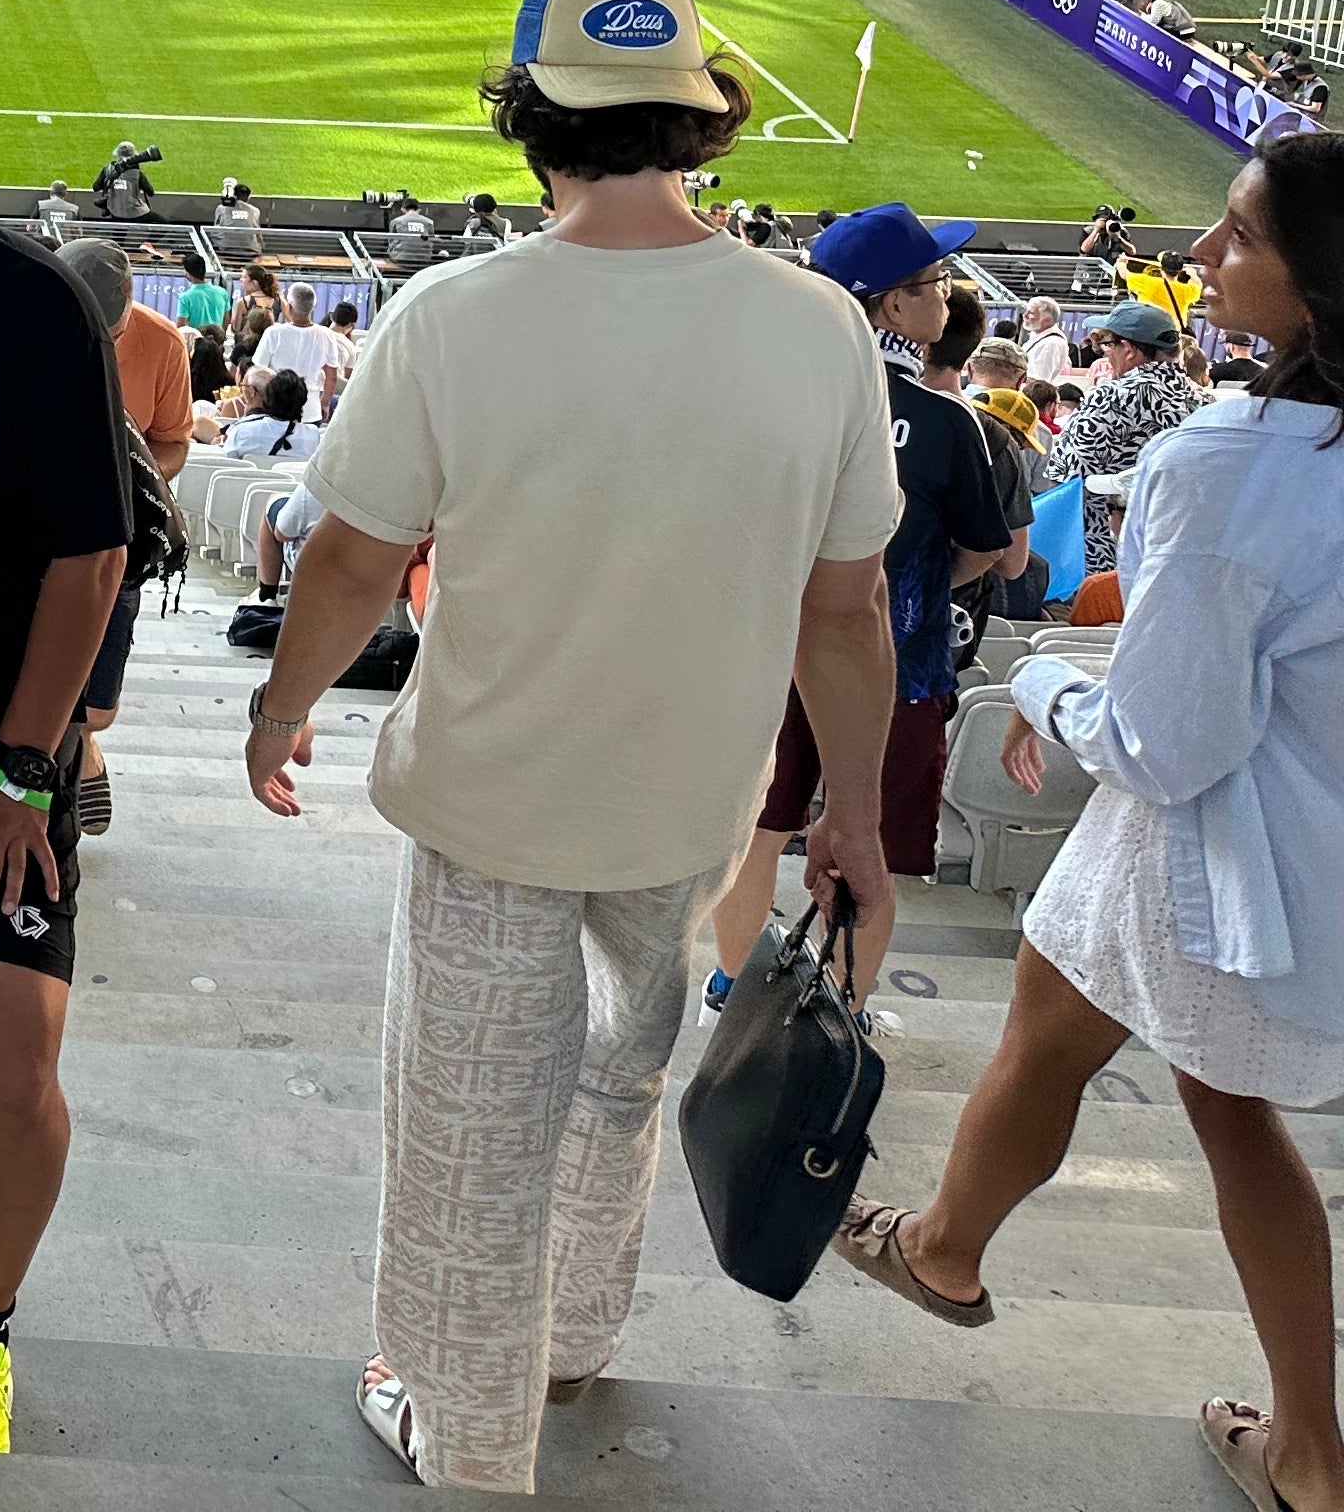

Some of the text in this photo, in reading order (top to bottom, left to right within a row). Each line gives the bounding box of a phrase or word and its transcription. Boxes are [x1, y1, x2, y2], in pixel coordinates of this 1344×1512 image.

[602, 1, 666, 32] Deus
[1104, 18, 1172, 72] PARIS 2024
